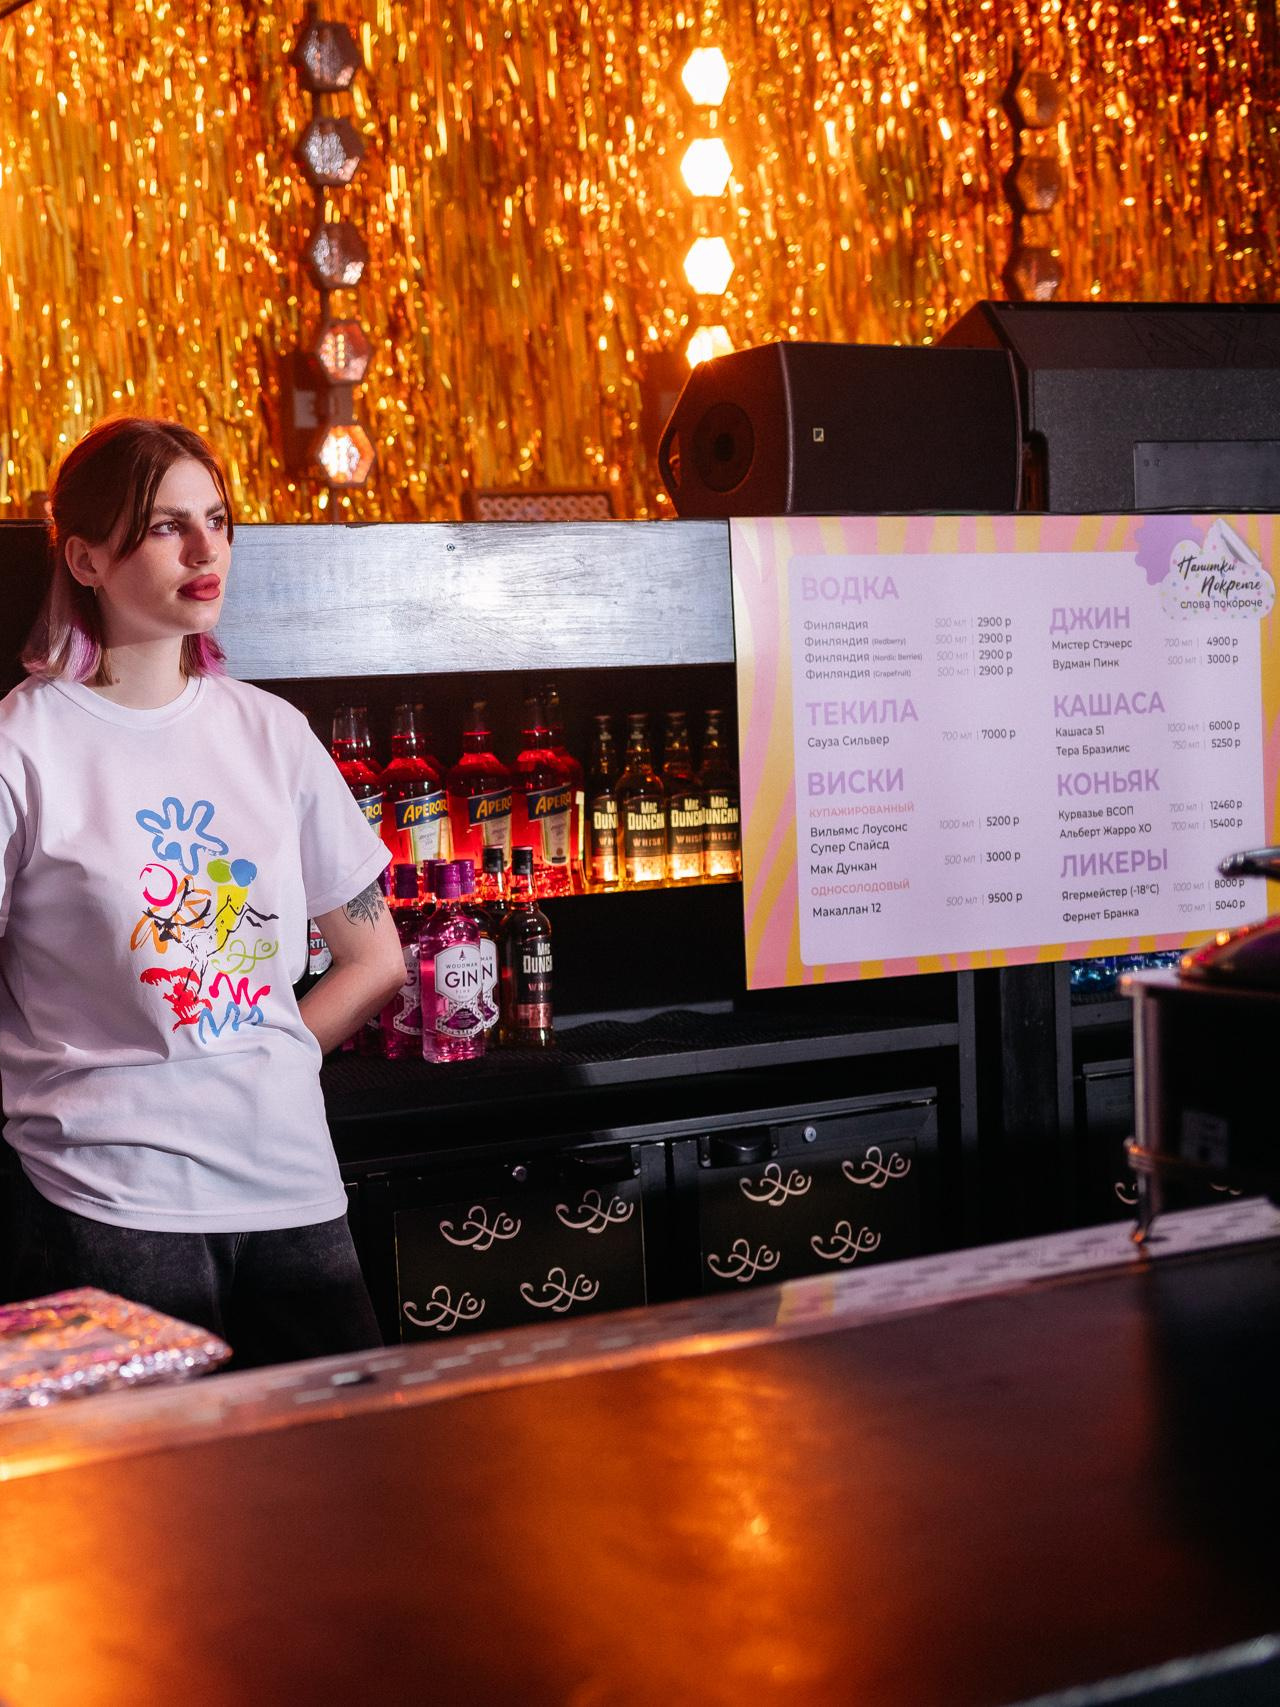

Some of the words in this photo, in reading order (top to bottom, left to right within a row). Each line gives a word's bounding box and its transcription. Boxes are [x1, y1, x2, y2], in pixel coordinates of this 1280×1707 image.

[801, 576, 900, 604] ВОДКА
[1180, 601, 1210, 610] слова
[1213, 598, 1263, 612] покороче
[804, 620, 868, 631] Финляндия
[977, 617, 1003, 627] 2900
[1005, 618, 1012, 629] р
[1049, 607, 1131, 634] ДЖИН
[804, 637, 869, 648] Финляндия
[978, 633, 1004, 643] 2900
[1006, 634, 1012, 646] р
[1052, 640, 1090, 650] Мистер
[1092, 639, 1132, 650] Стэчерс
[1206, 636, 1230, 646] 4900
[1232, 638, 1238, 648] р
[805, 653, 870, 663] Финляндия
[979, 650, 1004, 660] 2900
[1006, 652, 1013, 662] р
[1052, 659, 1090, 670] Вудман
[1094, 658, 1120, 668] Пинк
[1208, 654, 1230, 664] 3000
[1232, 656, 1238, 666] р
[806, 670, 870, 680] Финляндия
[979, 666, 1004, 676] 2900
[1006, 667, 1013, 678] р
[806, 699, 919, 726] ТЕКИЛА
[1054, 692, 1165, 718] КАШАСА
[807, 737, 840, 749] Сауза
[842, 735, 890, 747] Сильвер
[982, 729, 1007, 740] 7000
[1010, 730, 1016, 741] р
[1056, 728, 1093, 738] Кашаса
[1096, 726, 1104, 736] 51
[1209, 720, 1232, 731] 6000
[1234, 722, 1240, 732] р
[1056, 747, 1080, 756] Тера
[1082, 744, 1130, 754] Бразилис
[1212, 738, 1232, 748] 5250
[1234, 739, 1241, 749] р
[808, 768, 904, 796] ВИСКИ
[1058, 768, 1160, 796] КОНЬЯК
[809, 802, 914, 818] КУПАЖИРОВАННЫЙ
[1058, 808, 1104, 821] Курвазье
[1106, 806, 1134, 816] ВСОП
[1210, 800, 1235, 810] 12460
[1236, 800, 1243, 810] р
[810, 826, 859, 838] Вильямс
[862, 822, 908, 836] Лоусонс
[986, 816, 1011, 826] 5200
[1013, 817, 1020, 828] р
[1060, 828, 1102, 840] Альберт
[1104, 826, 1136, 837] Жарро
[1210, 818, 1236, 828] 15400
[1237, 819, 1243, 829] р
[810, 843, 846, 856] Супер
[848, 840, 890, 852] Спайсд
[810, 864, 834, 874] Мак
[836, 862, 877, 874] Дункан
[986, 851, 1012, 862] 3000
[1014, 852, 1021, 863] р
[1060, 848, 1168, 878] ЛИКЕРЫ
[810, 879, 910, 896] ОДНОСОЛОДОВЫЙ
[1062, 887, 1128, 901] Ягермейстер
[1214, 878, 1237, 888] 8000
[1238, 879, 1245, 890] р
[812, 904, 869, 918] Макаллан
[871, 902, 882, 912] 12
[988, 892, 1013, 904] 9500
[1016, 893, 1022, 904] р
[1062, 912, 1101, 923] Фернет
[1104, 908, 1140, 918] Бранка
[1216, 900, 1238, 910] 5040
[1240, 900, 1246, 910] р
[445, 970, 478, 988] GIN
